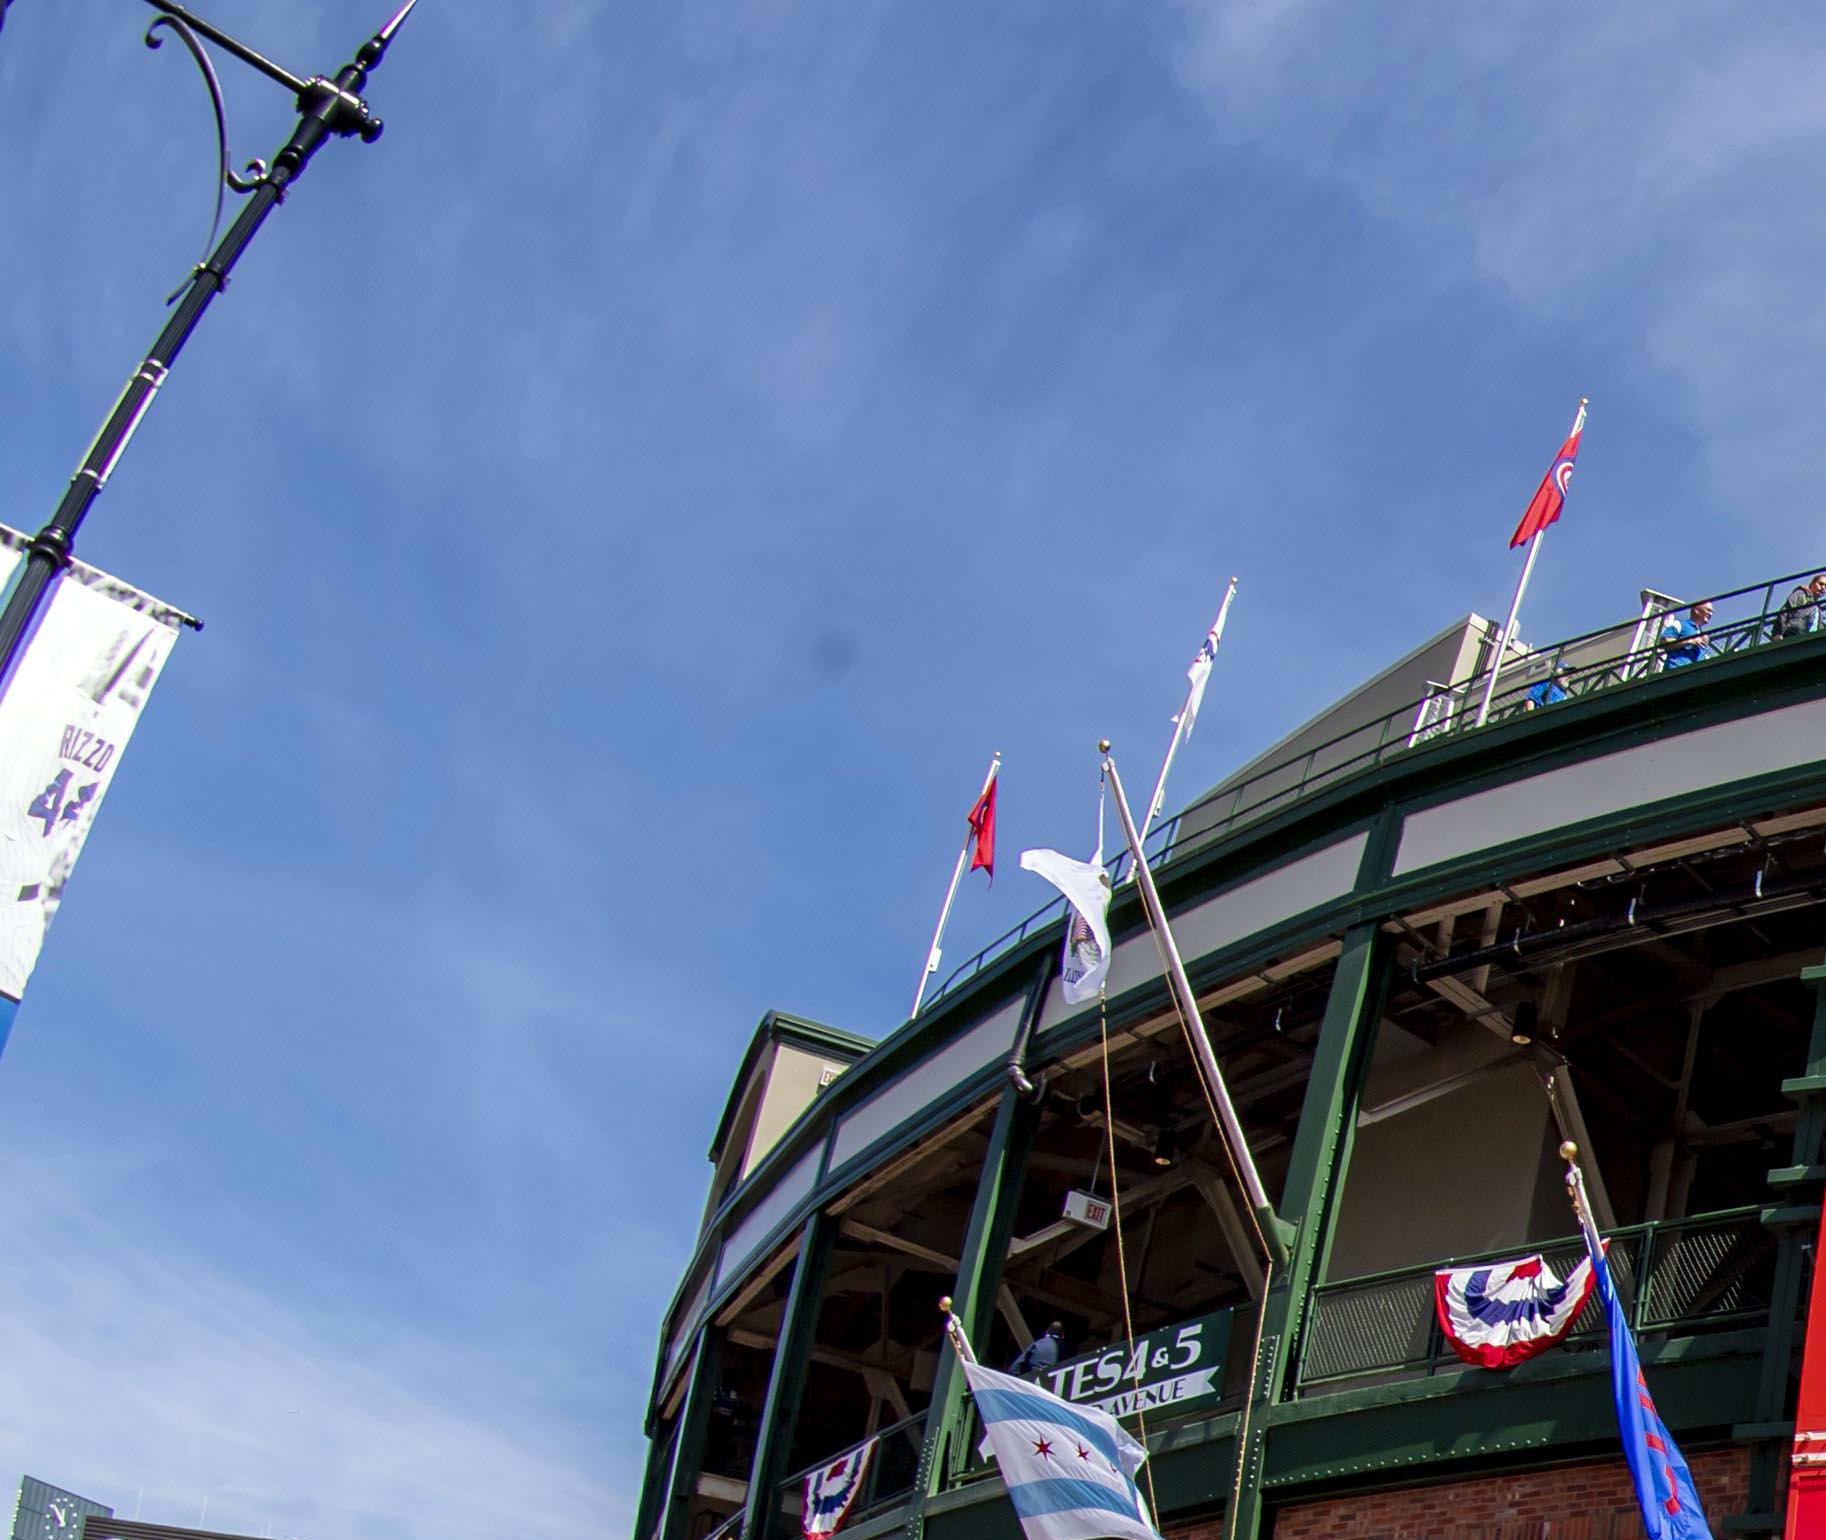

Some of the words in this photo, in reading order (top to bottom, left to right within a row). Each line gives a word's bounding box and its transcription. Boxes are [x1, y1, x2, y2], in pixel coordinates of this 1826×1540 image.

[59, 724, 115, 773] RIZZO
[1087, 1203, 1106, 1222] EXIT
[1036, 1351, 1124, 1401] TES
[1122, 1340, 1150, 1380] 4
[1151, 1347, 1168, 1369] &
[1170, 1324, 1203, 1370] 5
[1109, 1377, 1187, 1416] AVENUE
